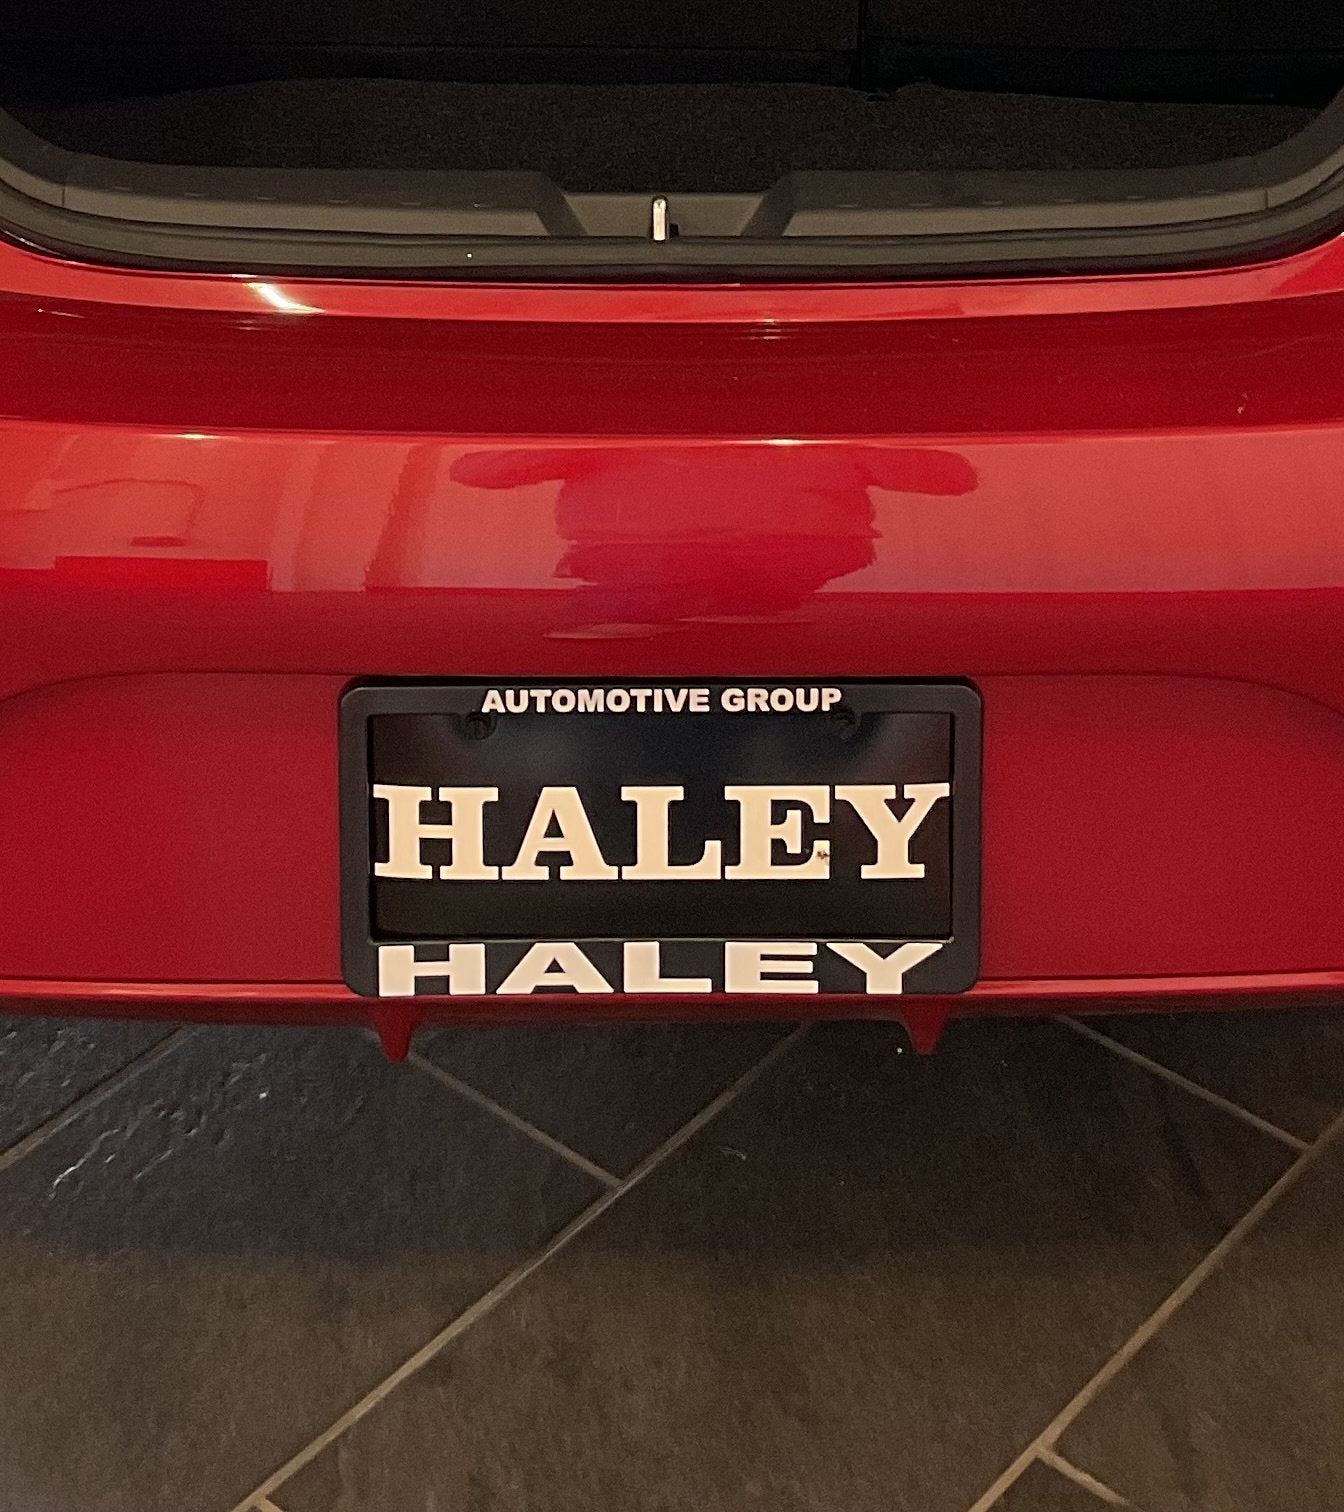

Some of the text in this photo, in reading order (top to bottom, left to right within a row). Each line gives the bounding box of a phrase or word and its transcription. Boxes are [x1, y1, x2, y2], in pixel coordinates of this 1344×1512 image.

[482, 687, 843, 714] AUTOMOTIVE GROUP
[372, 781, 951, 881] HALEY
[377, 940, 944, 997] HALEY
